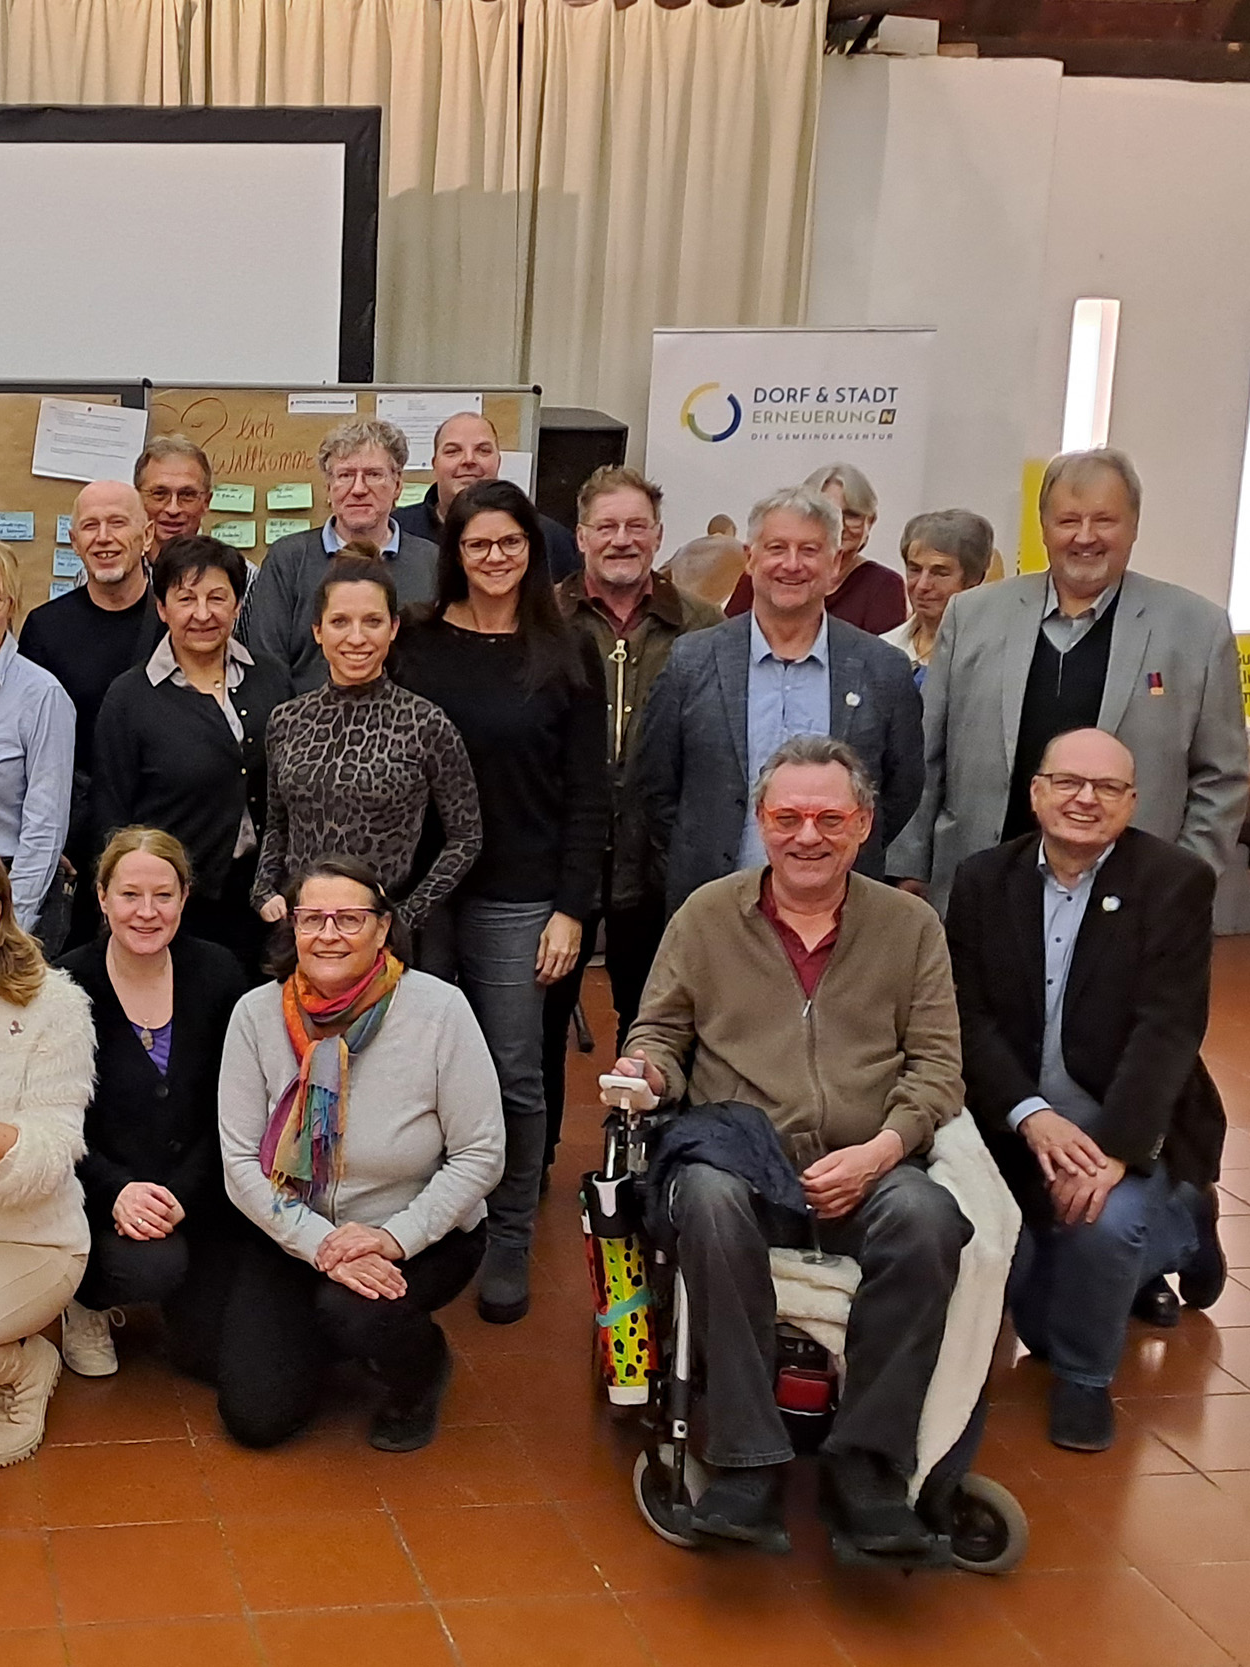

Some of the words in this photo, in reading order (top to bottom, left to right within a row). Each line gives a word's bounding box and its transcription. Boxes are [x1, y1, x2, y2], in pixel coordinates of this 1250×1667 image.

[753, 387, 811, 403] DORF
[816, 386, 829, 403] &
[835, 387, 899, 403] STADT
[752, 410, 876, 424] ERNEUERUNG
[776, 432, 894, 440] GEMEINDEAGENTUR
[212, 443, 316, 475] Willkomme
